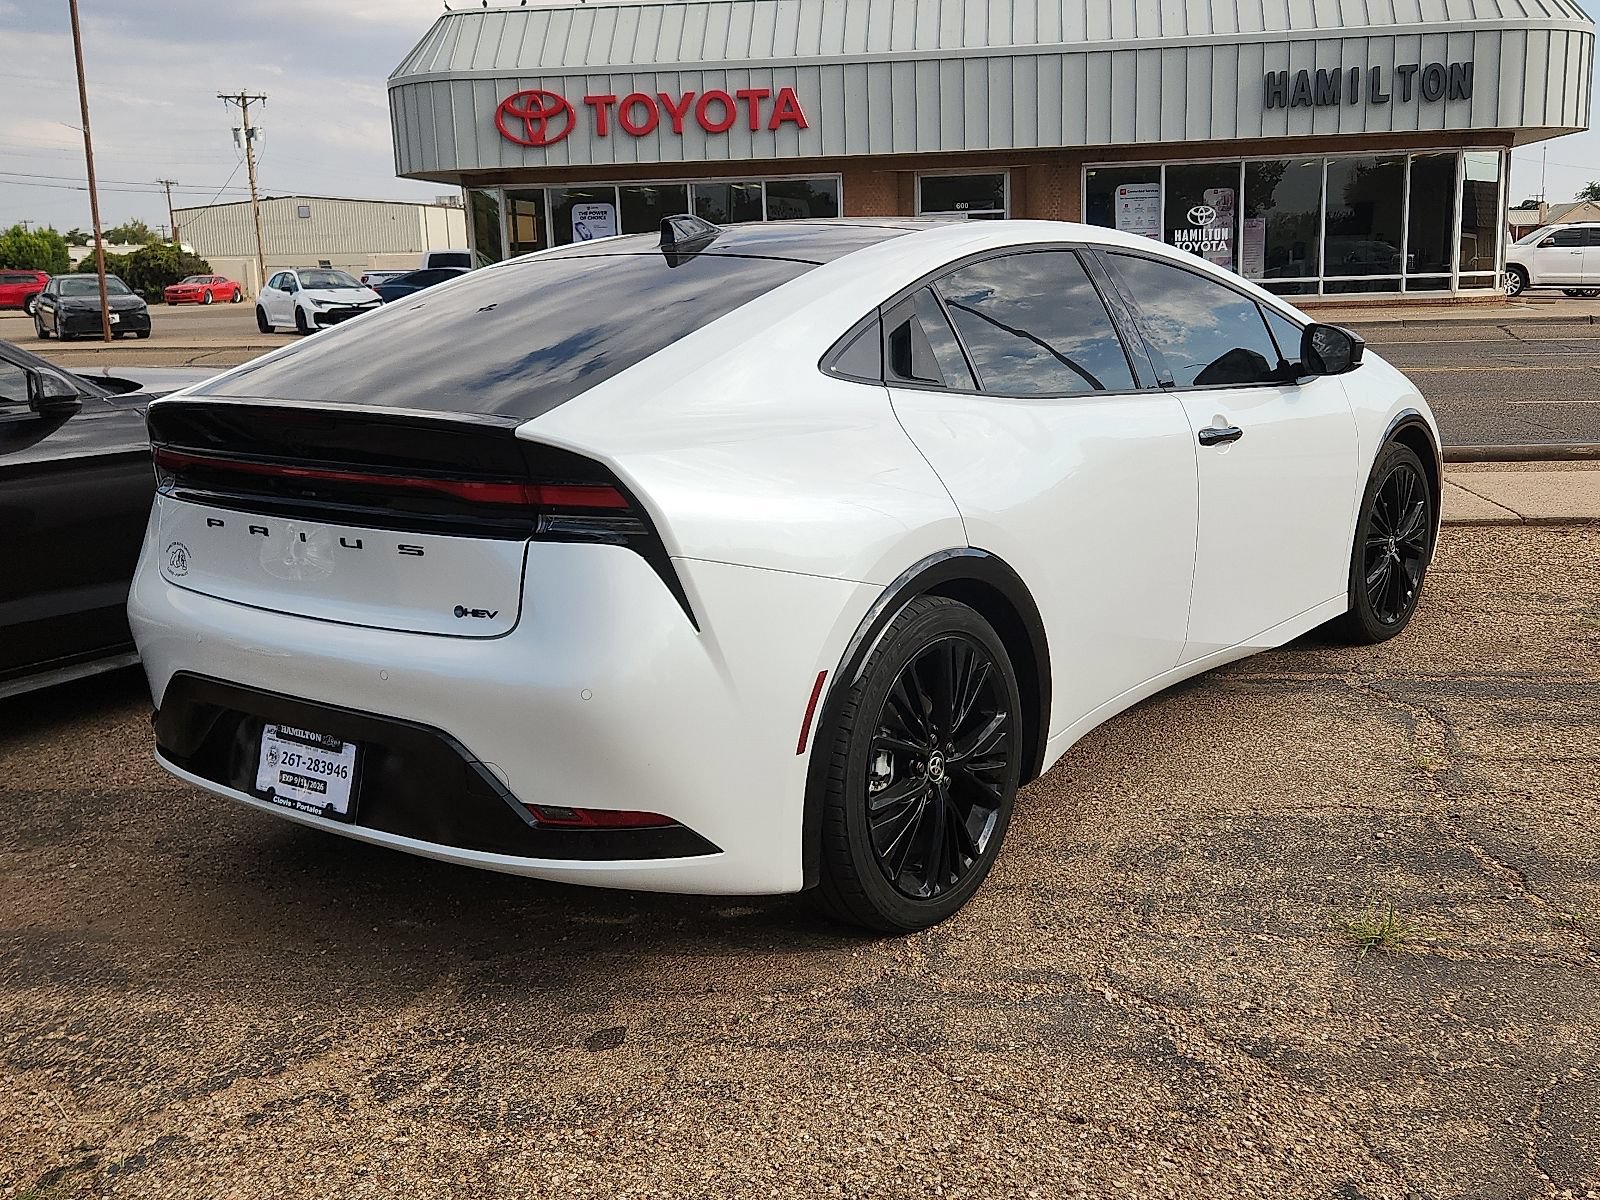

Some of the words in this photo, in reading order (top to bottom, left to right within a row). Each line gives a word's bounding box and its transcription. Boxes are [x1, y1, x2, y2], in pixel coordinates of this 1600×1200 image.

[1265, 61, 1474, 109] HAMILTON
[583, 87, 809, 137] TOYOTA
[1174, 228, 1229, 242] HAMILTON
[1174, 240, 1228, 252] TOYOTA
[206, 517, 425, 557] PRIUS
[463, 608, 498, 620] HEV
[281, 725, 322, 742] HAMILTON
[281, 751, 347, 779] 26T-283946
[282, 774, 293, 783] EXP
[272, 795, 292, 807] Clovis
[296, 802, 322, 815] Portales
